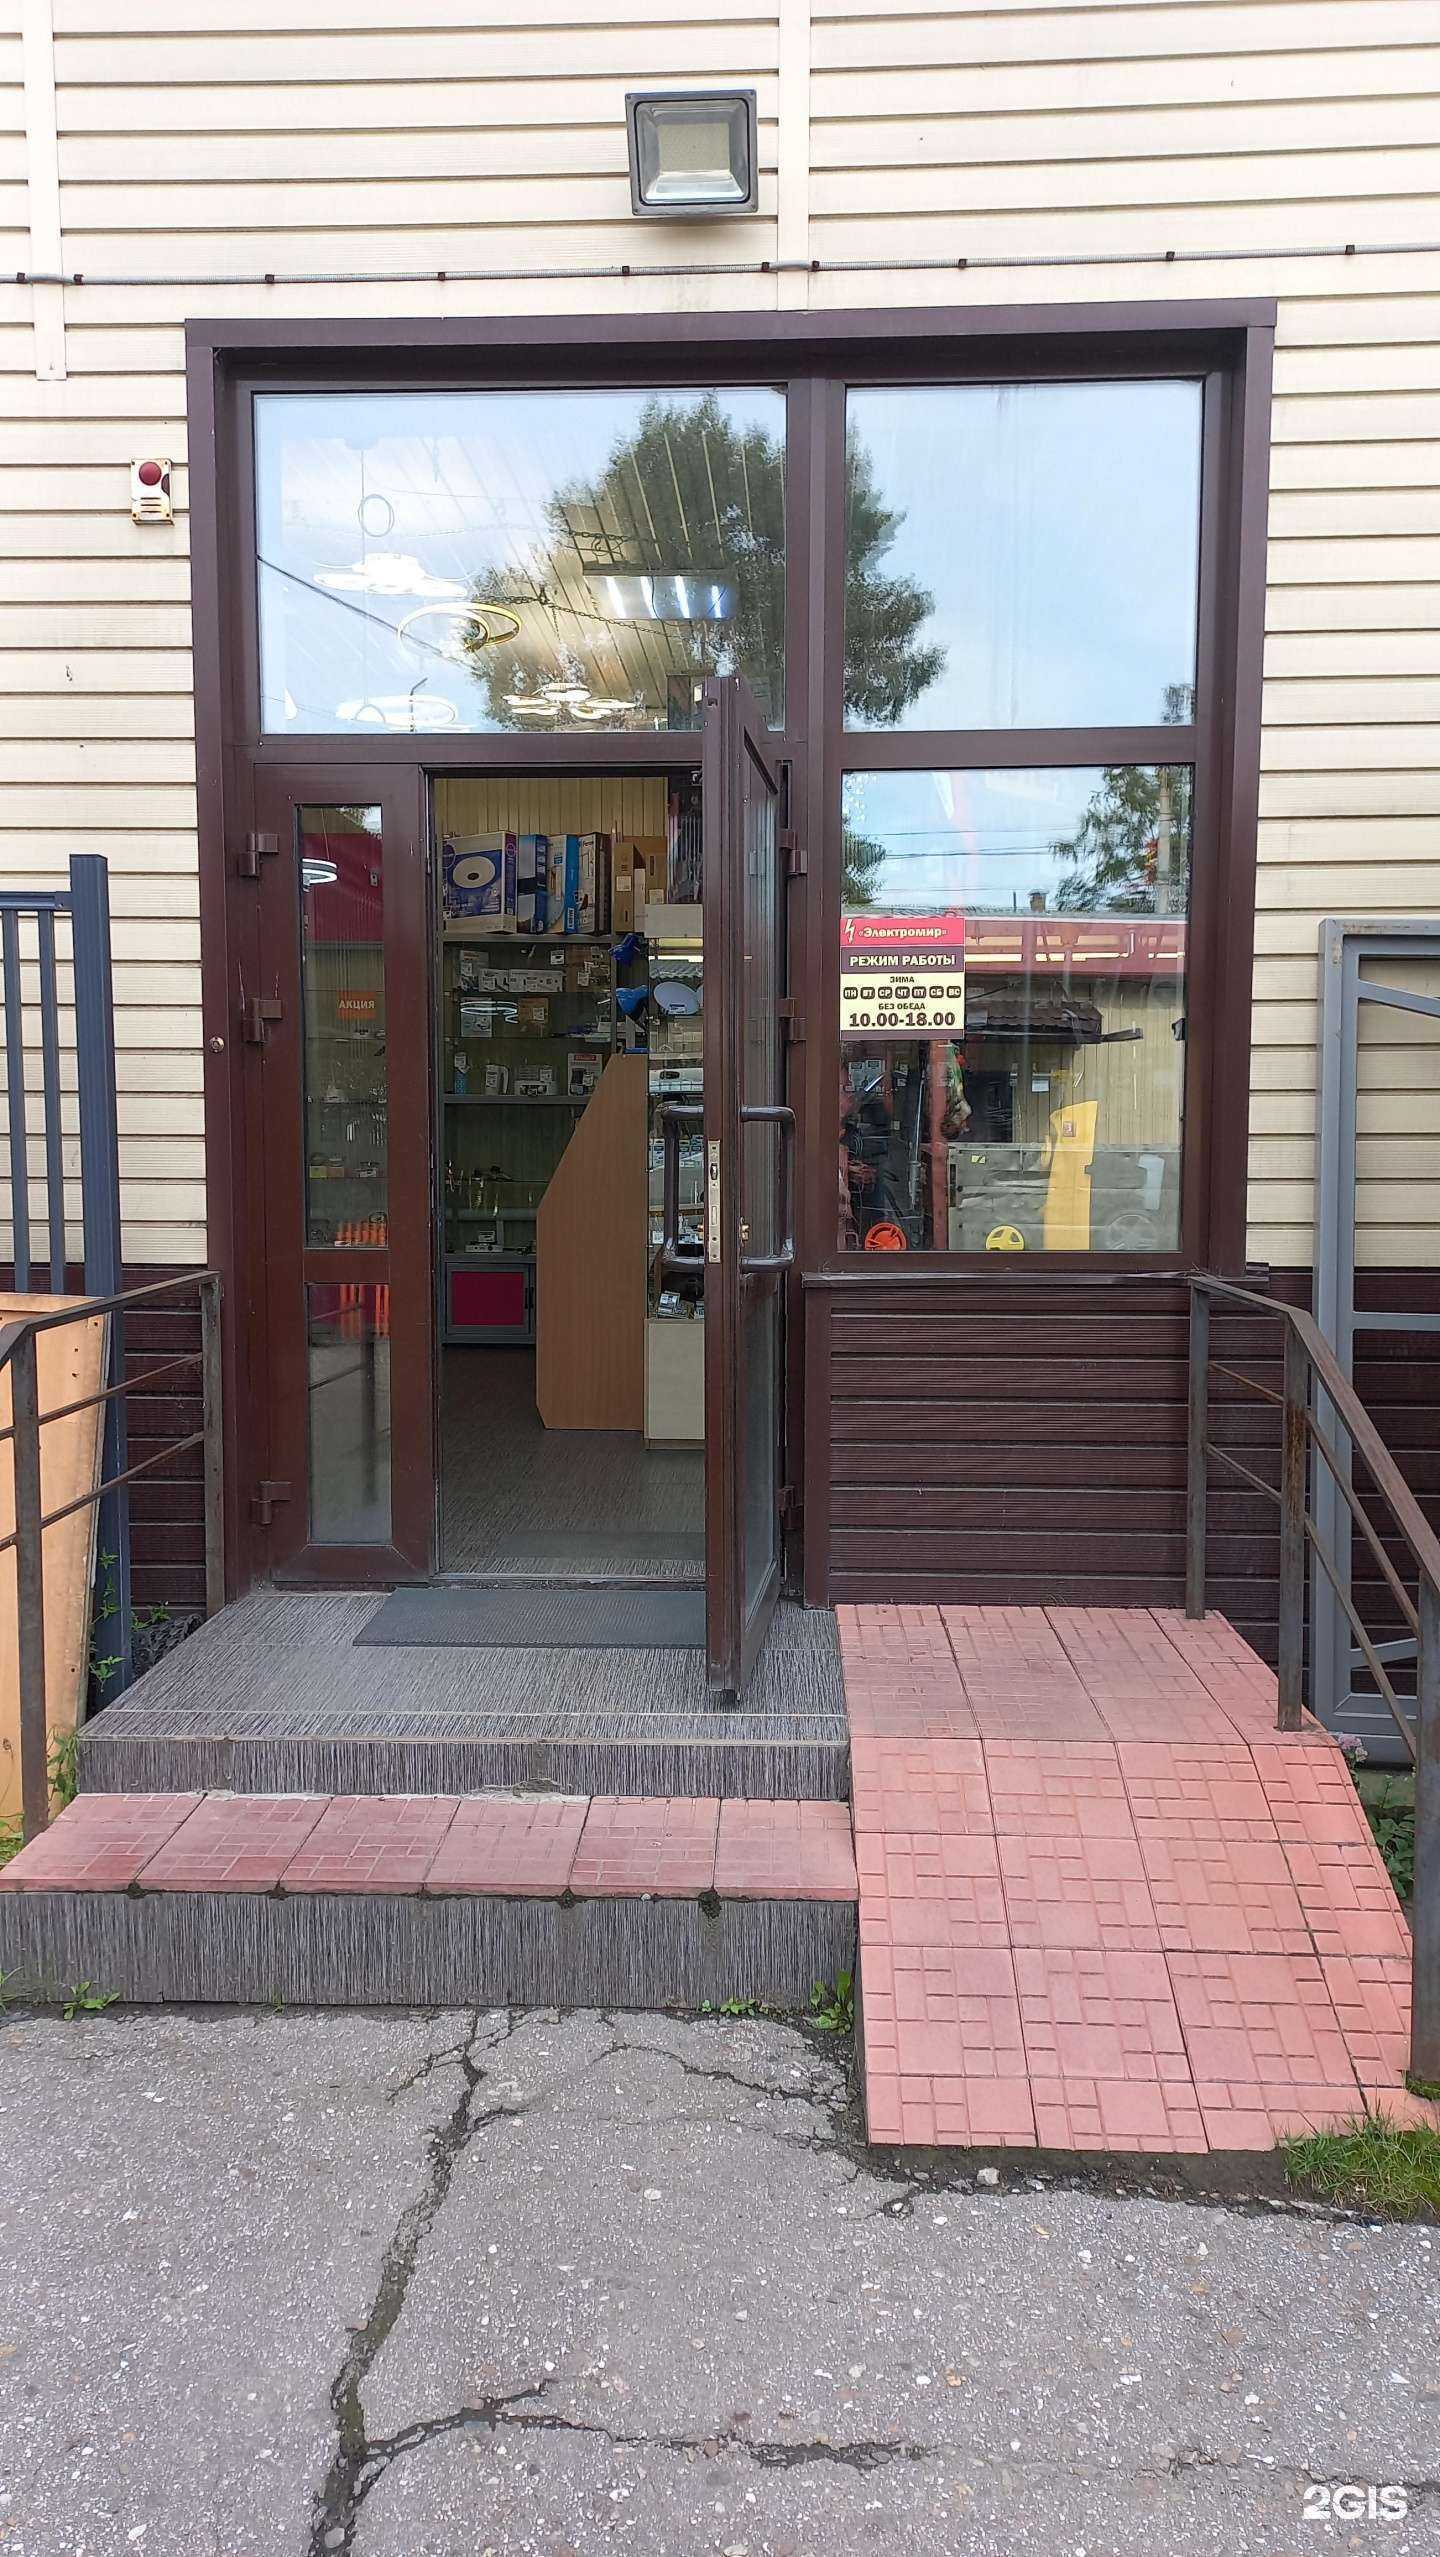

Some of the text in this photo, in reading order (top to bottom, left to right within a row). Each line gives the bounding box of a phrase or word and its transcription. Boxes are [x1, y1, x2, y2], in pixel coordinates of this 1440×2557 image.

[849, 955, 955, 967] РЕЖИМ РАБОТЫ
[844, 988, 857, 998] ПН
[879, 988, 892, 998] СР
[896, 987, 909, 997] ЧТ
[913, 987, 926, 997] ПТ
[930, 987, 943, 997] СБ
[947, 987, 960, 997] ВС
[338, 1000, 375, 1010] АКЦИЯ
[897, 1002, 926, 1010] ОБЕДА
[849, 1013, 955, 1027] 10.00-18.00
